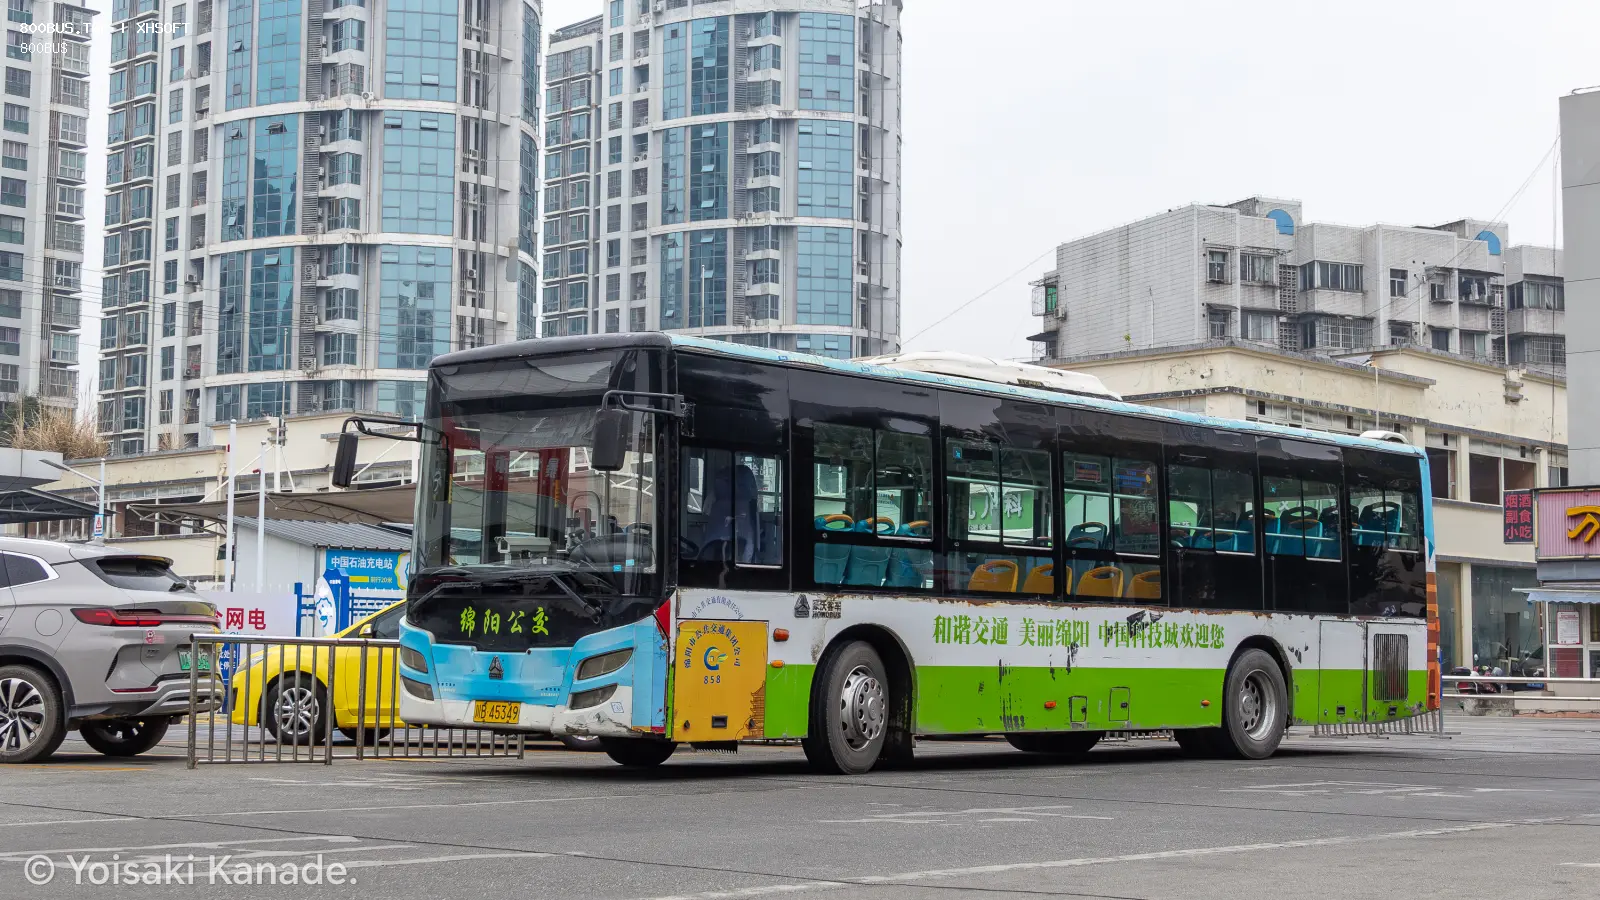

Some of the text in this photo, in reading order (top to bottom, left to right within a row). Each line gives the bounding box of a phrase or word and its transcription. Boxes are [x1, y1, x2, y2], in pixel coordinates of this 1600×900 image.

[1505, 493, 1532, 508] 烟酒
[1505, 509, 1532, 524] 副食
[1505, 525, 1532, 539] 小吃
[331, 556, 393, 569] 中国石油充电站
[215, 607, 267, 630] 网电
[460, 606, 549, 638] 绵阳公交
[932, 613, 1226, 650] 和谐交通 美丽绵阳 中国科技城欢迎您
[703, 675, 721, 685] 858
